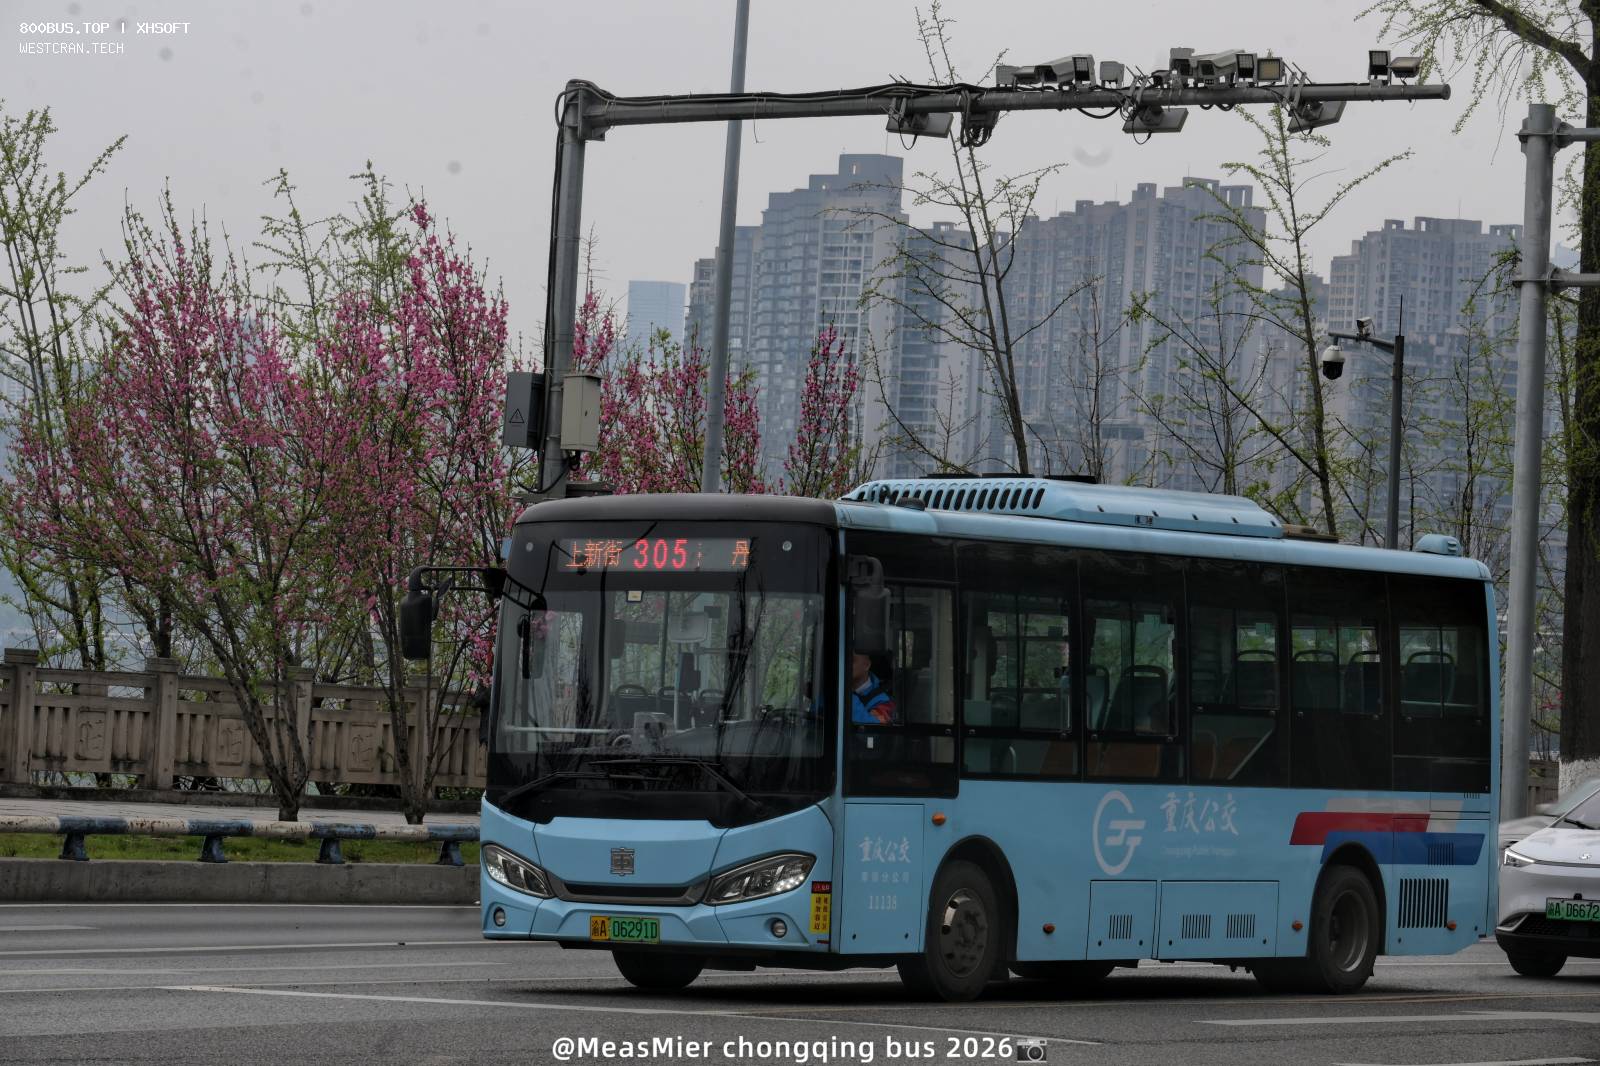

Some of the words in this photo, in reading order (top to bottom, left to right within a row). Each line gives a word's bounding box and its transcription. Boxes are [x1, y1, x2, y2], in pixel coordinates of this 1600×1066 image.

[565, 539, 623, 568] 上新街
[633, 538, 689, 569] 305
[1160, 790, 1240, 836] 重庆公交
[858, 836, 911, 863] 重庆公交
